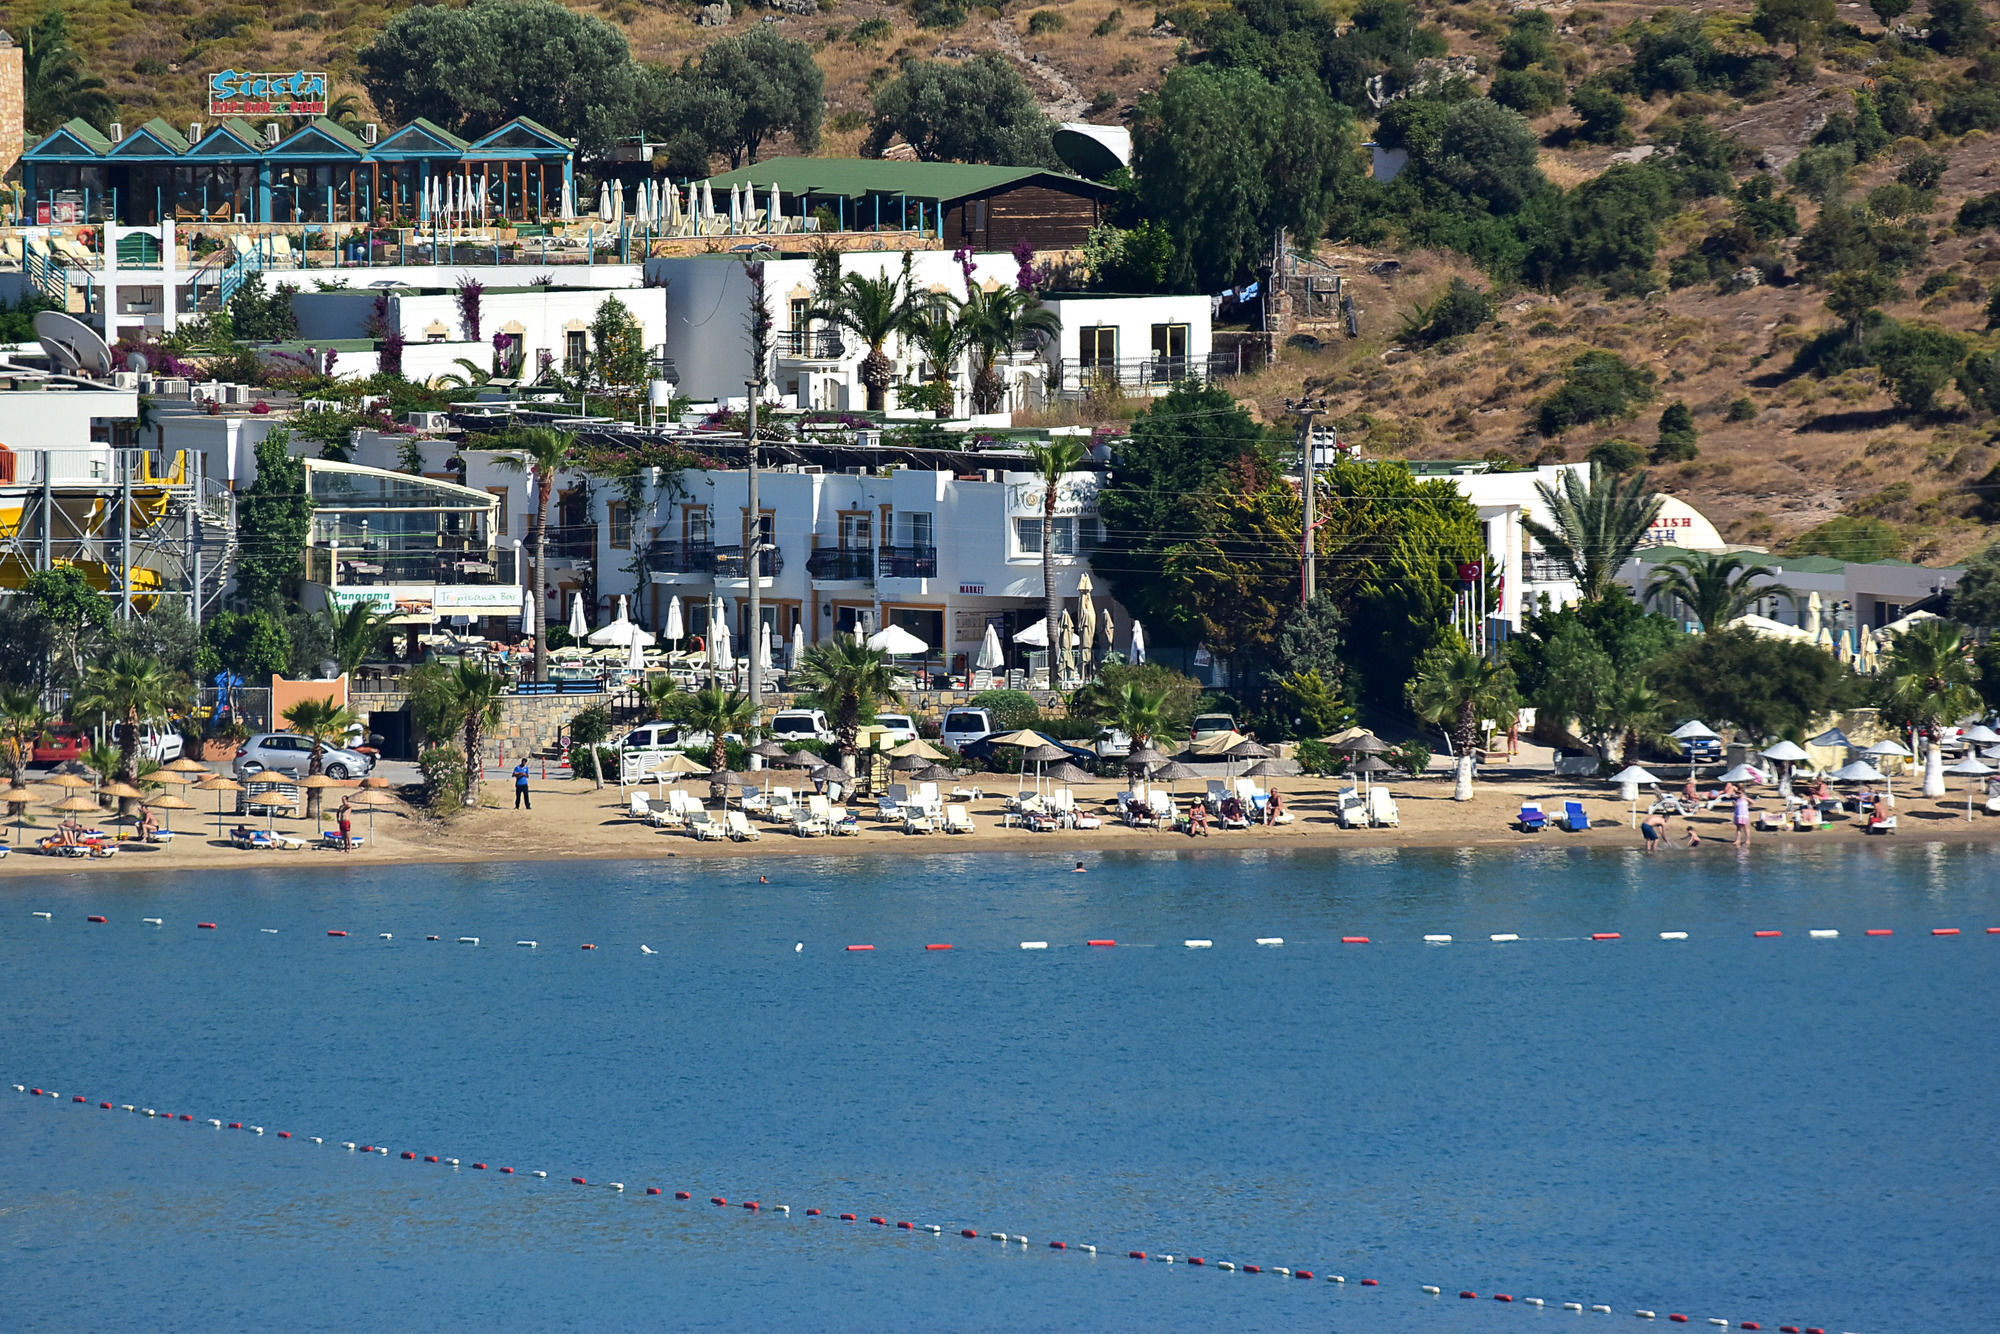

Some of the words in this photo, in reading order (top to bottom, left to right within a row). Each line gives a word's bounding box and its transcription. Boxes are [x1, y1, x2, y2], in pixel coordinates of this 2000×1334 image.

[213, 69, 323, 99] Siesta
[212, 101, 238, 113] TOP
[244, 101, 271, 113] BAR
[275, 102, 286, 113] &
[290, 101, 325, 113] POOL
[1006, 482, 1100, 514] Tropcan
[1054, 505, 1079, 514] EACH
[1081, 504, 1105, 514] HOT
[335, 591, 390, 601] Panorama
[959, 585, 984, 595] MARKET
[440, 591, 497, 604] Tropicana
[500, 592, 517, 601] Bar
